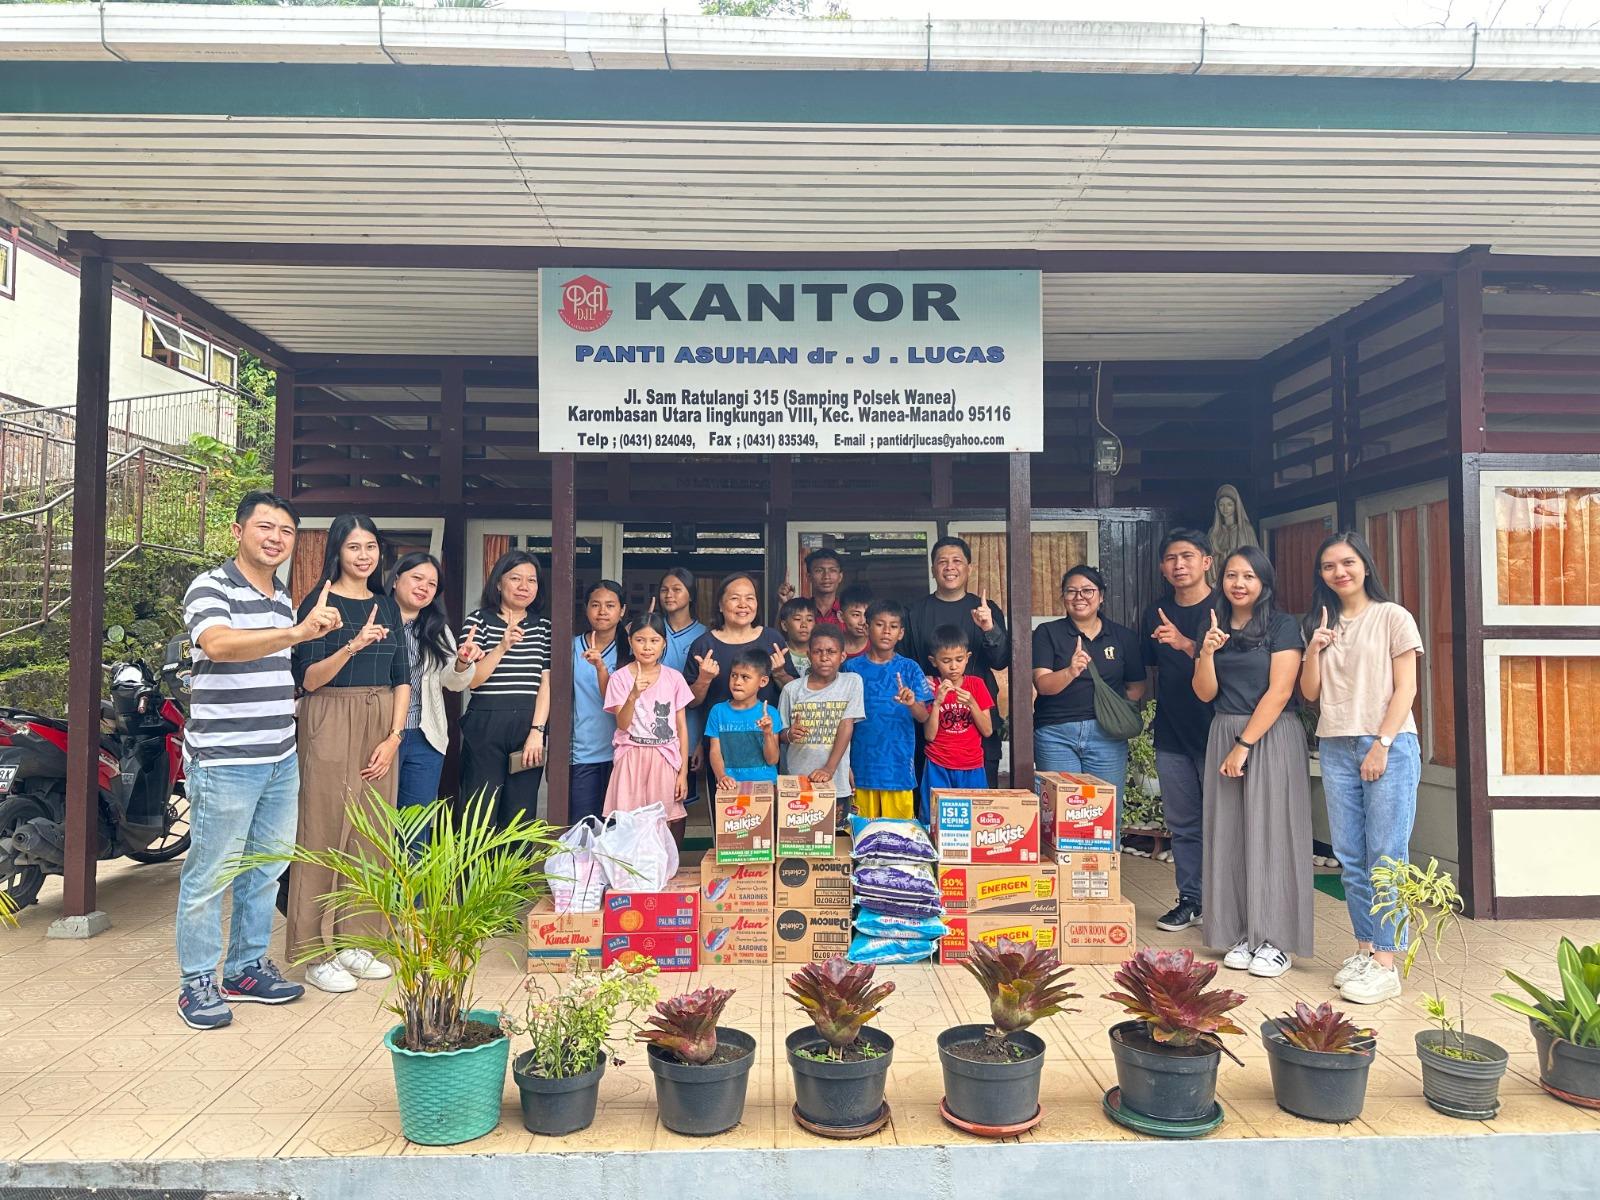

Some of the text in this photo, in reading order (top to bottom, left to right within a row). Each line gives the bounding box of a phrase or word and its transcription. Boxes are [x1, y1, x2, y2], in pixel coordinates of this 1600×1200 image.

[635, 282, 961, 322] KANTOR
[577, 308, 596, 321] DJL
[575, 345, 665, 363] PANTI
[674, 346, 798, 364] ASUHAN
[908, 345, 1006, 364] LUCAS
[623, 388, 957, 409] Jl. Sam Ratulangi 315 (Samping Polsek Wanea)
[568, 405, 1011, 426] Karombasan Utara lingkungan VIII, Kec. Wanea-Manado 95116
[620, 434, 652, 449] (0431)
[655, 434, 696, 449] 824049,
[709, 432, 732, 446] Fax
[743, 434, 775, 449] (0431)
[778, 434, 818, 448] 835349,
[834, 434, 866, 446] E-mail
[877, 434, 1005, 448] pantidrjlucas@yahoo.com
[786, 809, 825, 828] Malkist
[943, 808, 968, 817] ISI 3
[1065, 805, 1104, 821] Malkist
[724, 814, 762, 833] Malkist
[980, 816, 1001, 824] Roma
[976, 824, 1025, 847] Malkist
[731, 865, 769, 880] Atan
[811, 863, 851, 876] Dancow
[942, 878, 963, 886] 30%
[981, 880, 1028, 895] ENERGEN
[658, 917, 692, 926] PALING ENAK
[730, 916, 768, 930] Atan
[780, 922, 804, 930] Cokelat
[810, 917, 850, 931] Dancow
[545, 933, 590, 945] Kunci Mas
[949, 928, 965, 936] 0%
[657, 957, 691, 965] PALING ENAK
